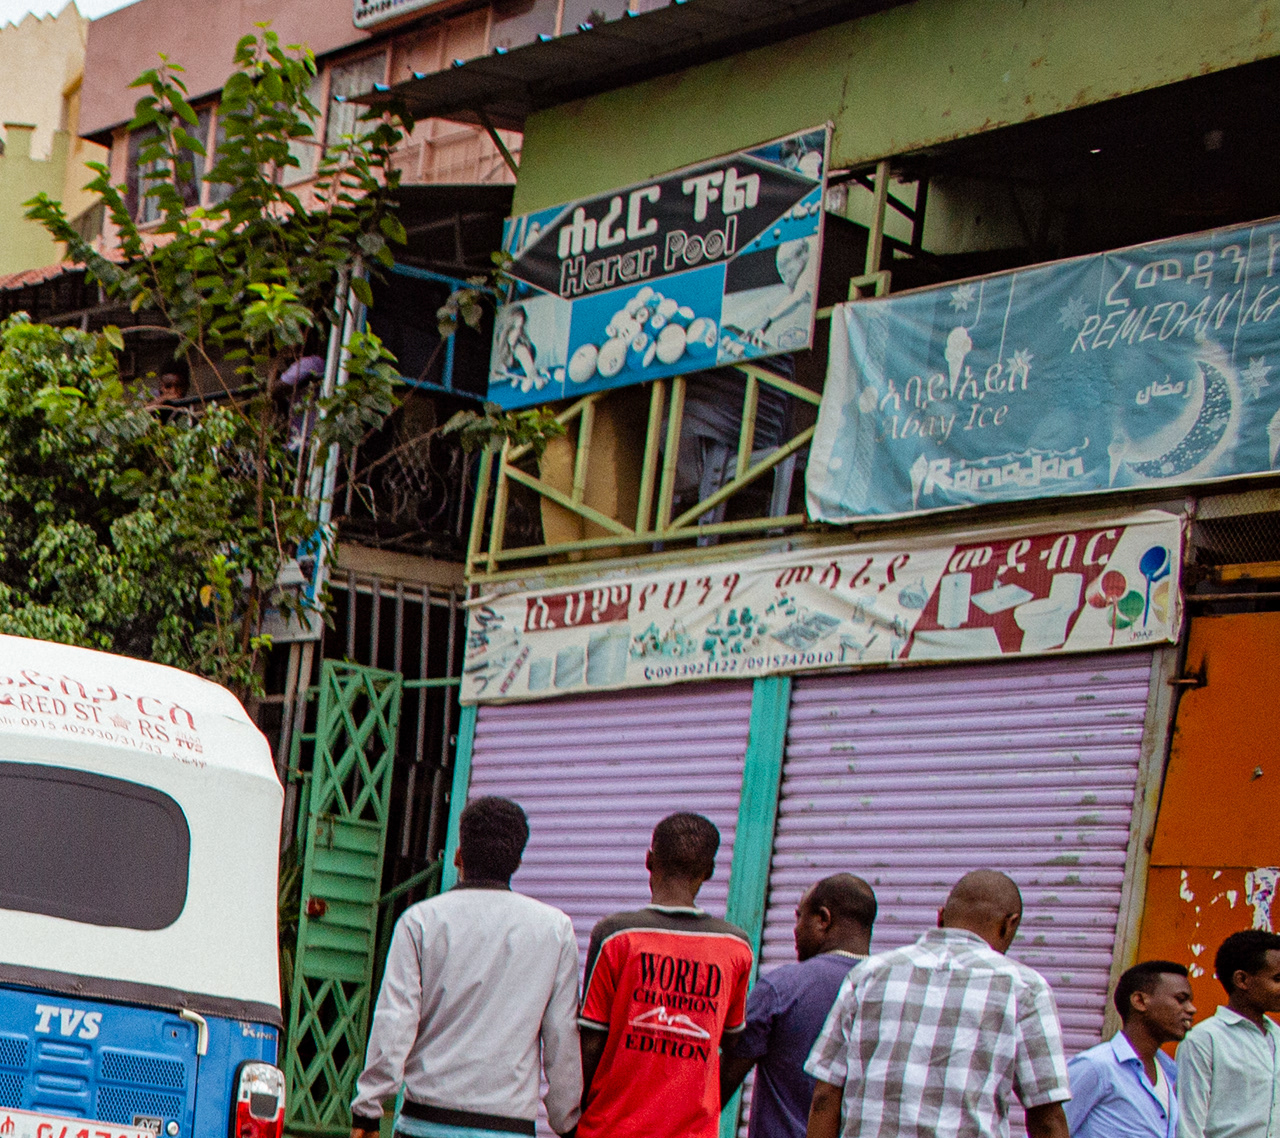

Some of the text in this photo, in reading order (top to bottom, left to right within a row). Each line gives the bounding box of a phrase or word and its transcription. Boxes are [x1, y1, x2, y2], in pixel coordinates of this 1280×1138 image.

[559, 214, 738, 298] Harar Pool
[1070, 289, 1243, 354] REMEDAN
[963, 403, 1009, 430] Ice
[923, 455, 1085, 496] Ramadan
[19, 694, 68, 717] RED
[640, 951, 722, 999] WORLD
[633, 986, 718, 1014] CHAMPION
[34, 1003, 104, 1040] TVS
[625, 1033, 712, 1063] EDITION
